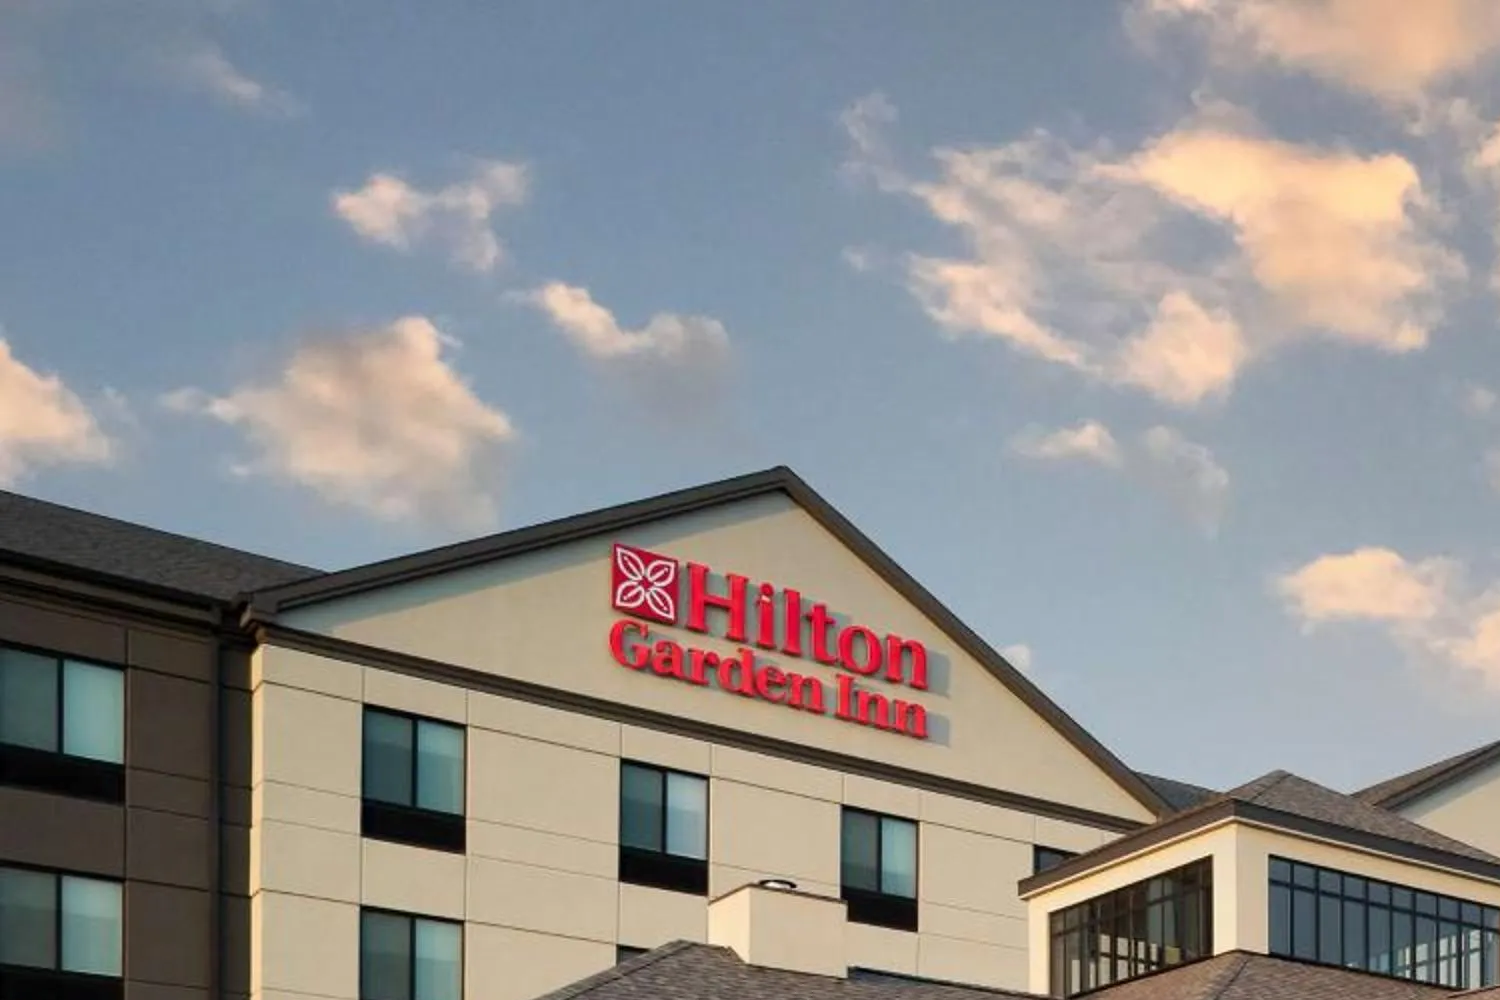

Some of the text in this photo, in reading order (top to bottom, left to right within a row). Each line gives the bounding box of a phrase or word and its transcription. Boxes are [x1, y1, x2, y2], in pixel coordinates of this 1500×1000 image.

[609, 618, 928, 739] Garden Inn
[686, 561, 928, 690] Hilton
